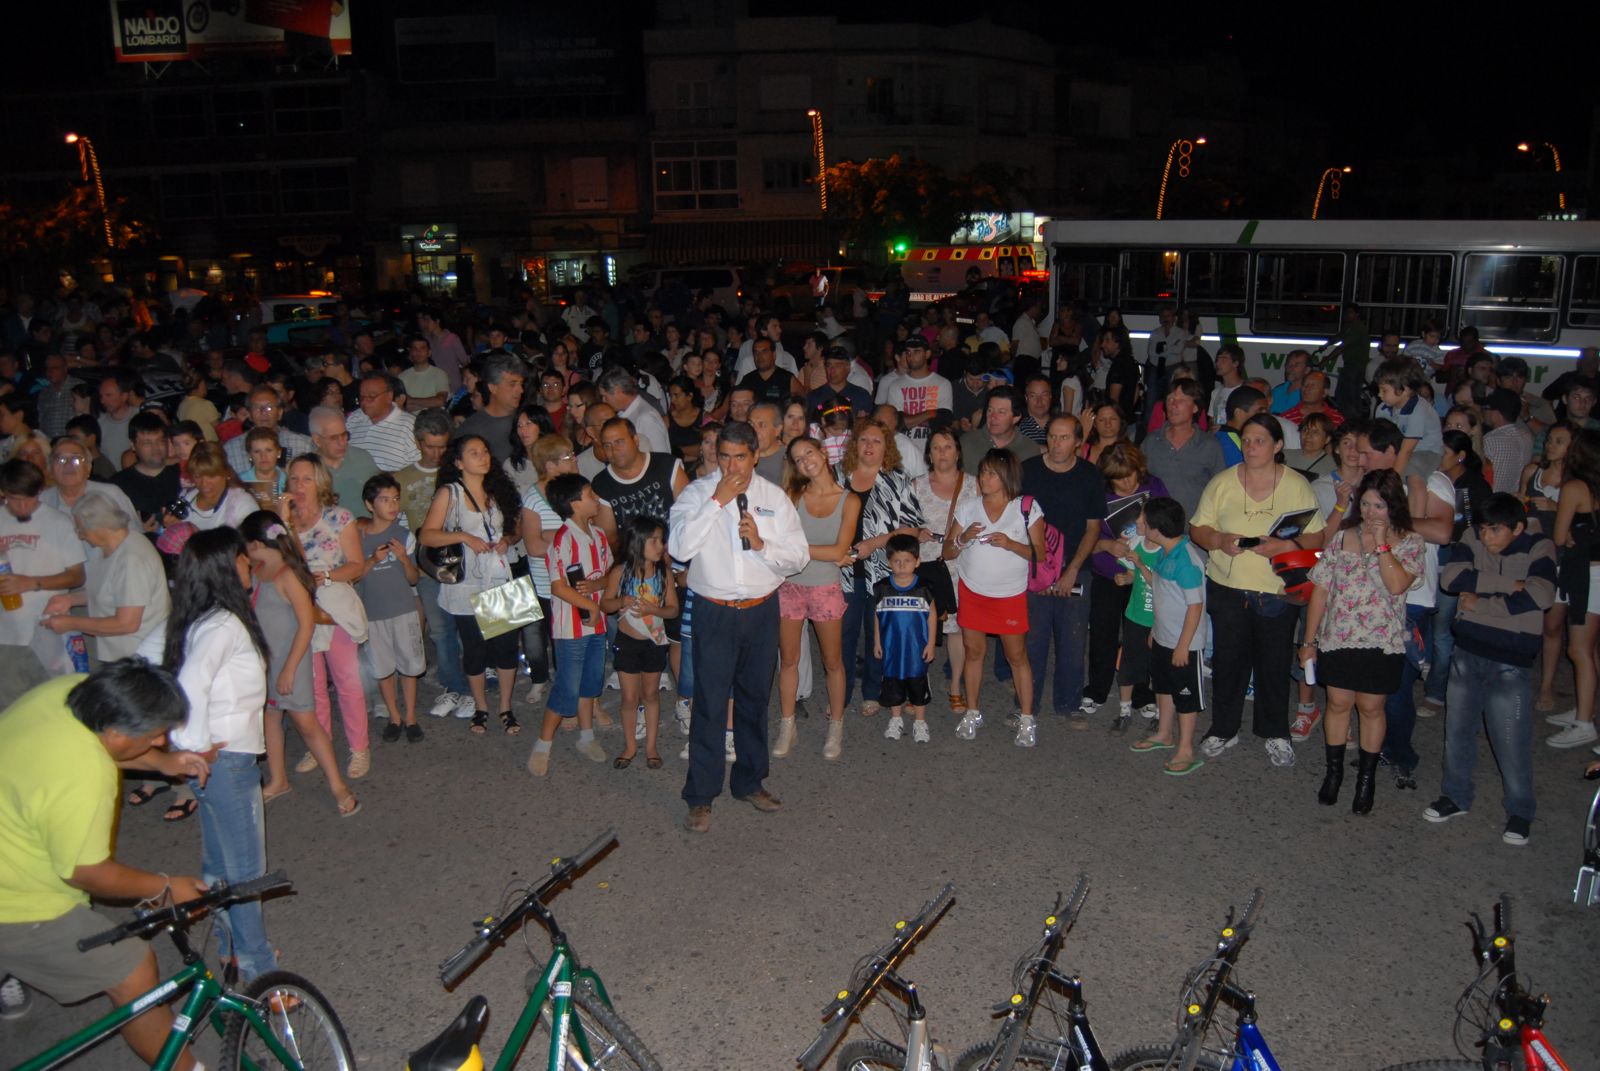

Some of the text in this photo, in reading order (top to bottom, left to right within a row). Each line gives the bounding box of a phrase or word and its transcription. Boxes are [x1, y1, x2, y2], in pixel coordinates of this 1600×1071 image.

[124, 16, 180, 35] NALDO
[126, 34, 181, 47] LOMBARDI
[901, 386, 927, 401] YOU
[903, 400, 926, 416] ARE
[611, 481, 661, 507] DONATO
[886, 597, 919, 607] NIKE
